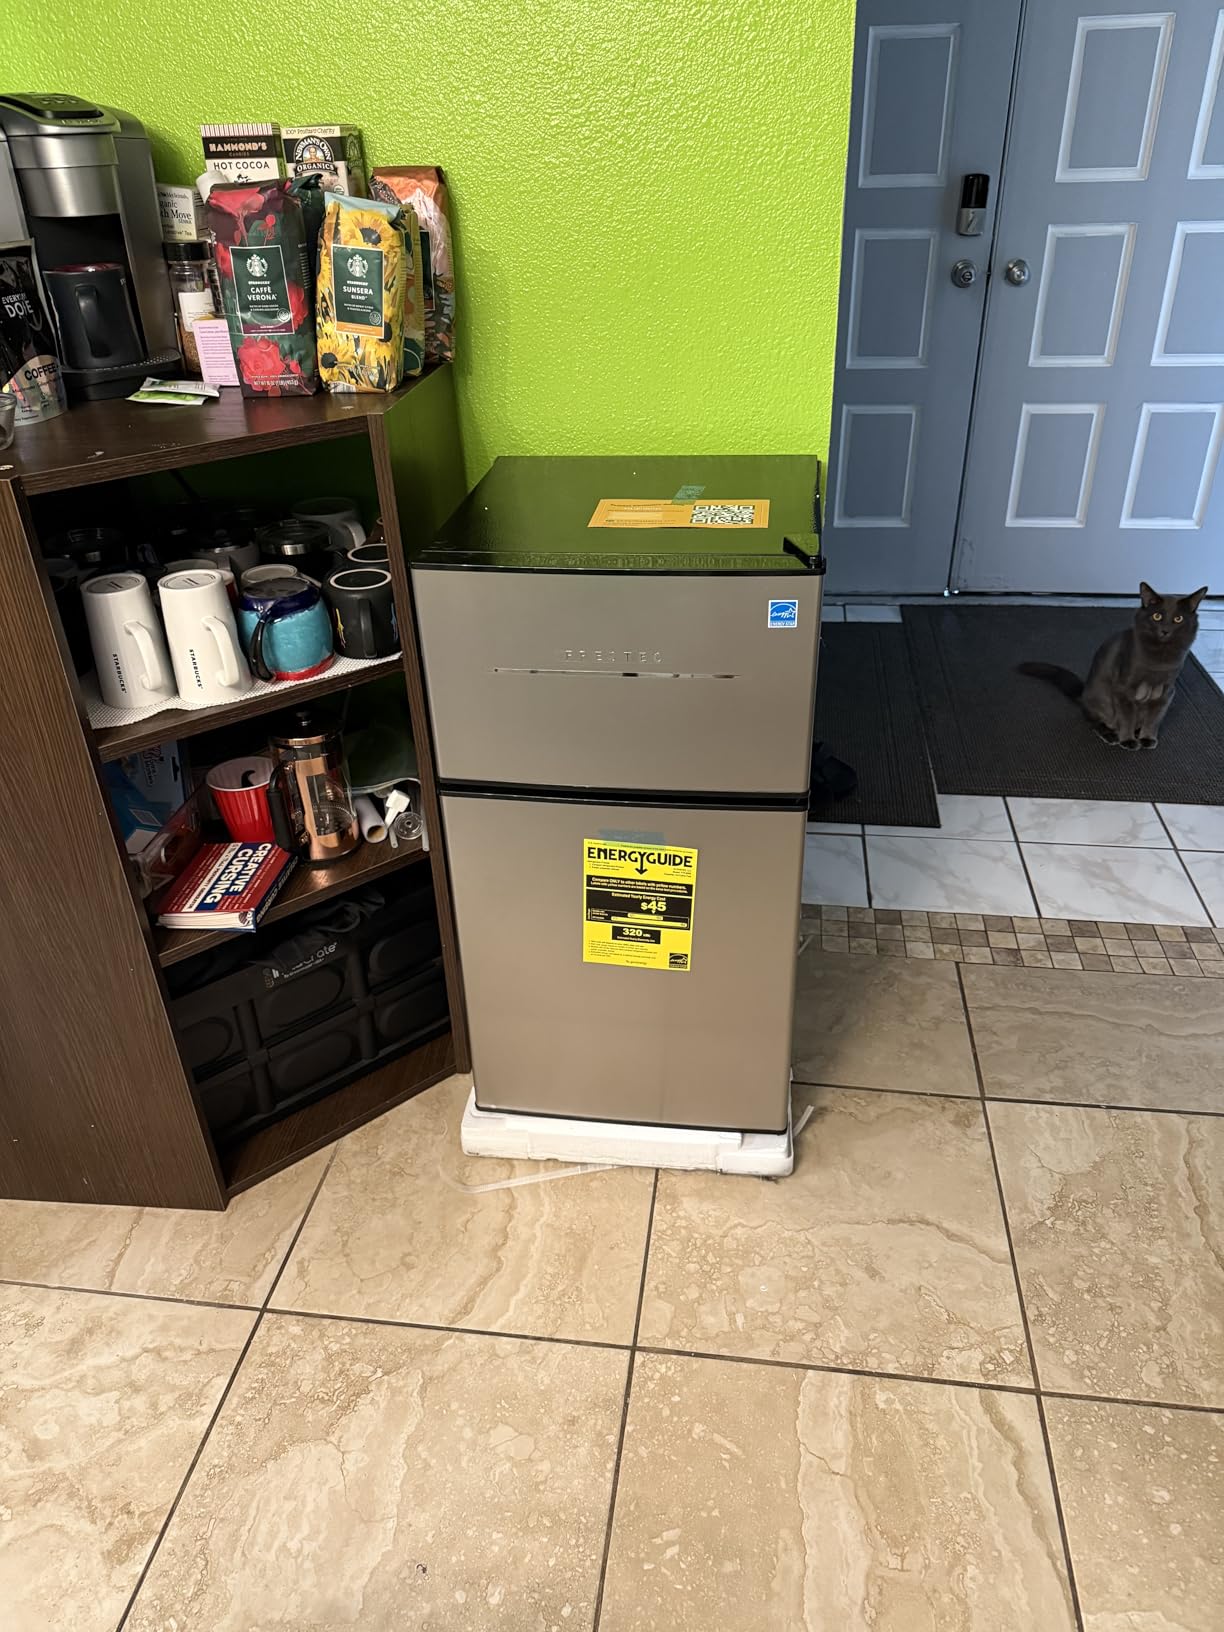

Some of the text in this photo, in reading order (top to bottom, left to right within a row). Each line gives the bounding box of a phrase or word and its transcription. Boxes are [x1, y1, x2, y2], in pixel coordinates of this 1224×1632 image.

[209, 142, 267, 152] HAMMOND'S
[213, 161, 270, 170] HOT COCOA
[297, 163, 335, 172] ORGANICS
[171, 209, 192, 219] Move
[342, 286, 374, 295] SUNSERA
[112, 653, 127, 693] STARBUCKS
[189, 649, 204, 689] STARBUCKS
[588, 847, 693, 869] ENERGYGUIDE
[229, 842, 272, 893] CREATIVE
[203, 848, 254, 904] CURSING
[640, 900, 667, 912] $45
[622, 928, 643, 937] 320
